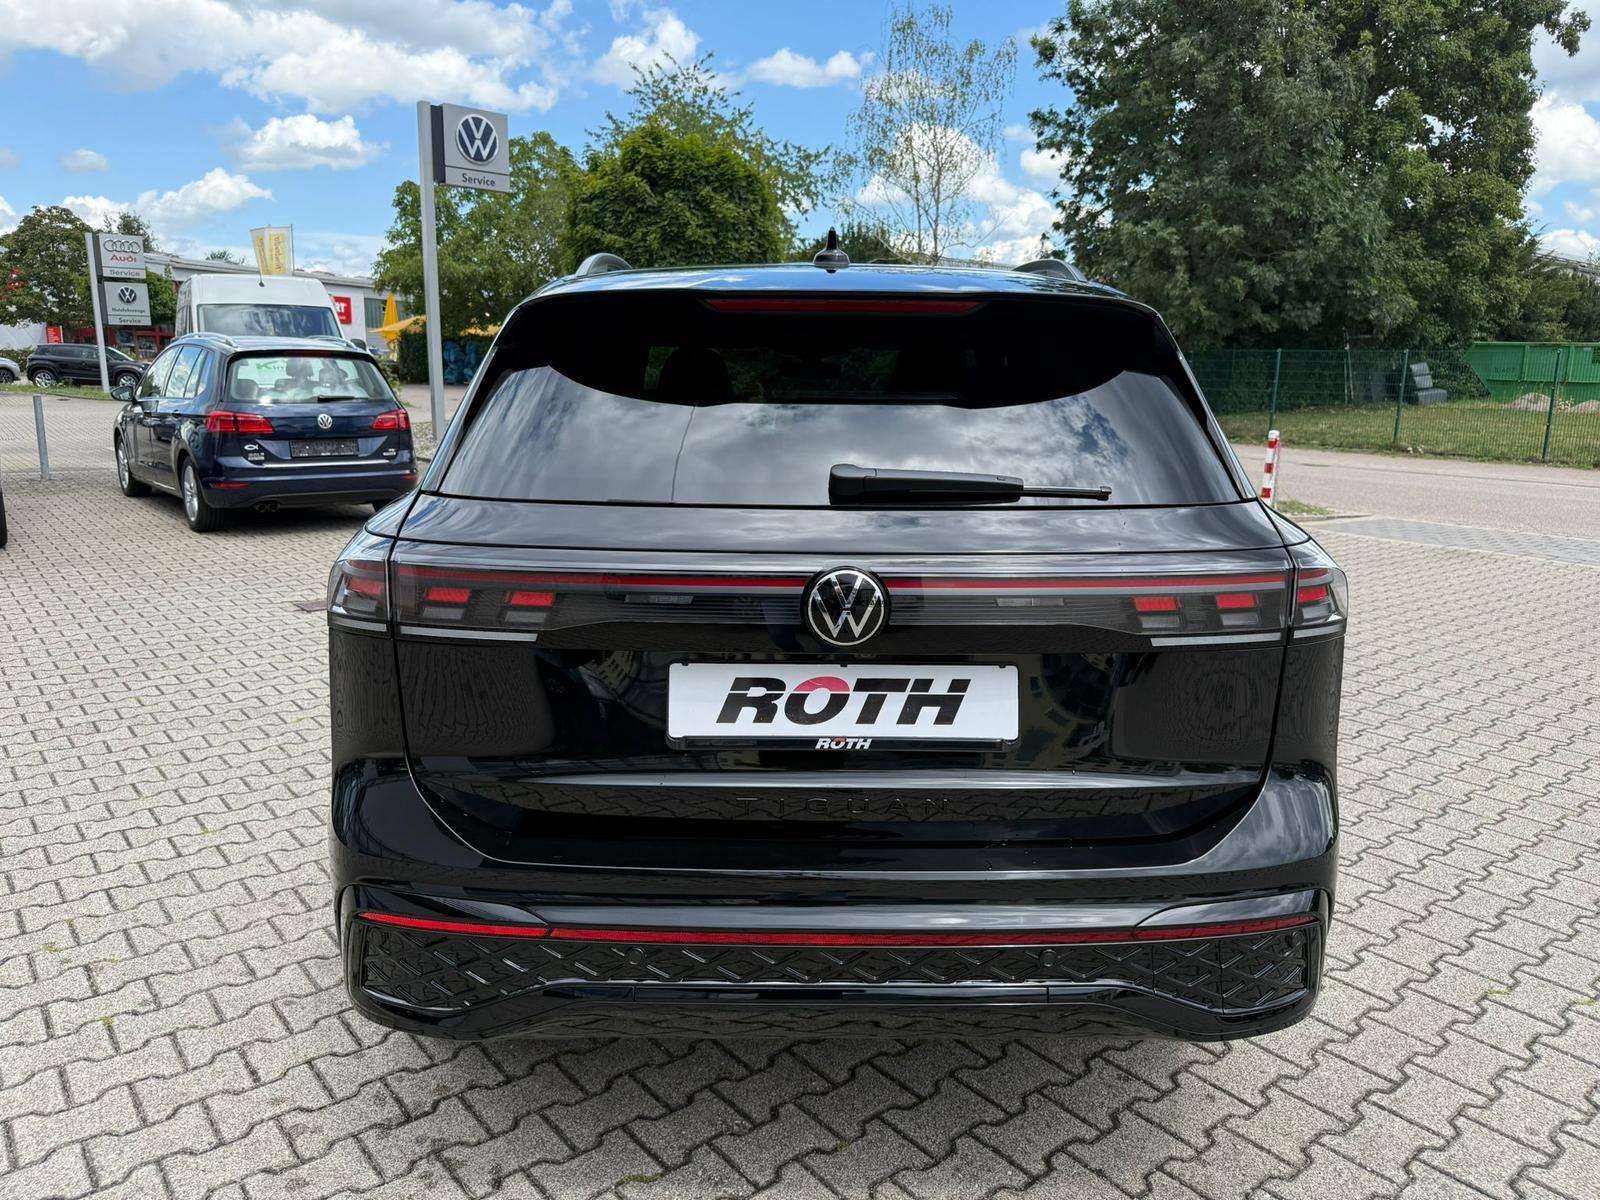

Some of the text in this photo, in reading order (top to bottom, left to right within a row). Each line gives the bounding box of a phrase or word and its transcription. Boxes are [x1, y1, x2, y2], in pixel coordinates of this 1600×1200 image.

[462, 173, 496, 187] Service
[110, 254, 137, 263] Audi
[109, 269, 141, 277] Service
[715, 676, 972, 726] ROTH
[815, 736, 873, 750] ROTH
[735, 798, 952, 816] TIGUAN
